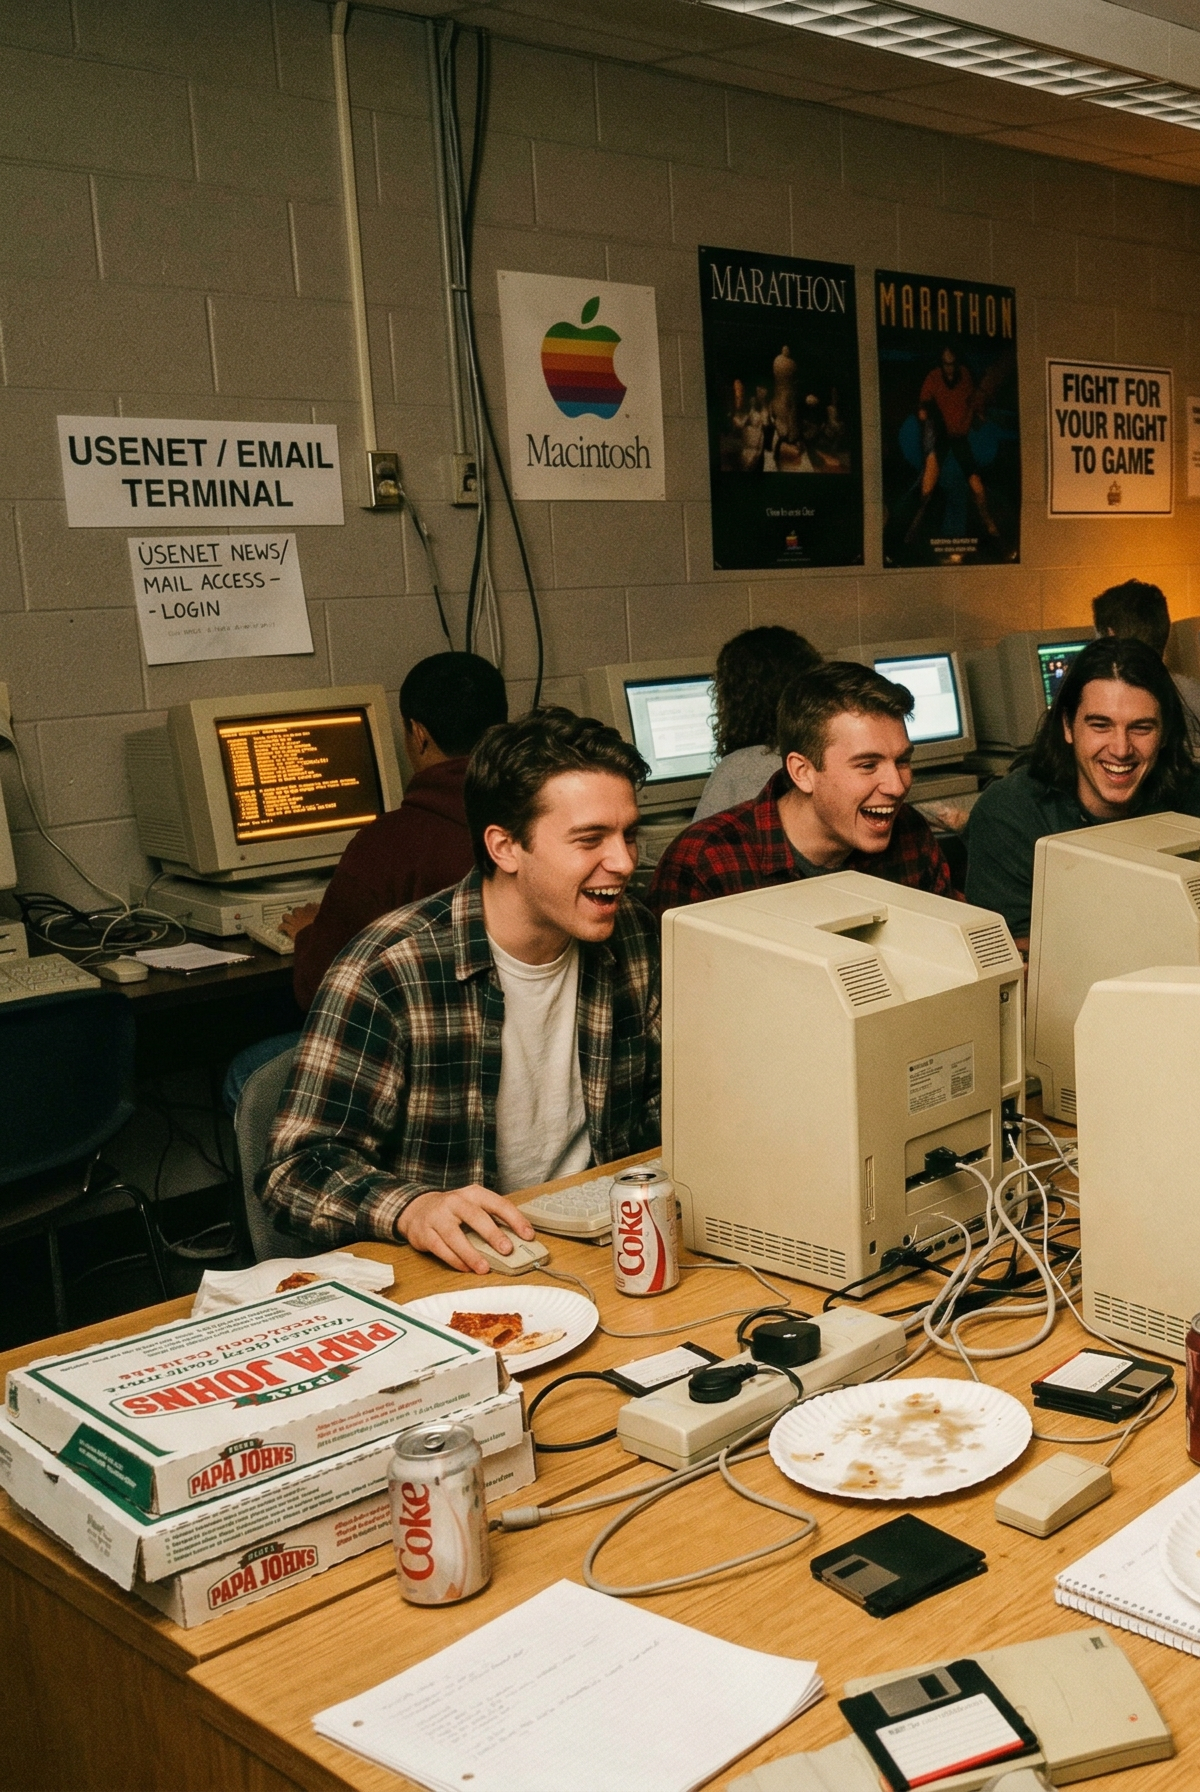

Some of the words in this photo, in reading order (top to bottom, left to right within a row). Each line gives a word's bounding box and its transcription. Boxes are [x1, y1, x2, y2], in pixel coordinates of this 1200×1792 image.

[711, 263, 847, 314] MARATHON
[880, 282, 1014, 338] MARATHON
[1062, 373, 1119, 405] FIGHT
[1125, 378, 1161, 408] FOR
[1055, 409, 1107, 439] YOUR
[1113, 413, 1167, 442] RIGHT
[68, 436, 207, 466] USENET
[217, 439, 227, 467] /
[238, 440, 334, 469] EMAIL
[526, 434, 651, 471] Macintosh
[1071, 445, 1096, 474] TO
[1102, 446, 1155, 475] GAME
[122, 478, 294, 508] TERMINAL
[138, 542, 221, 566] USENET
[231, 539, 289, 565] NEWS/
[144, 576, 193, 595] MAIL
[617, 1200, 645, 1277] Coke
[275, 1323, 398, 1374] PAPA
[122, 1360, 287, 1417] JOHNS
[191, 1458, 236, 1495] PAPA
[399, 1481, 435, 1582] Coke
[211, 1565, 258, 1607] PAPA
[260, 1548, 316, 1587] JOHNS
